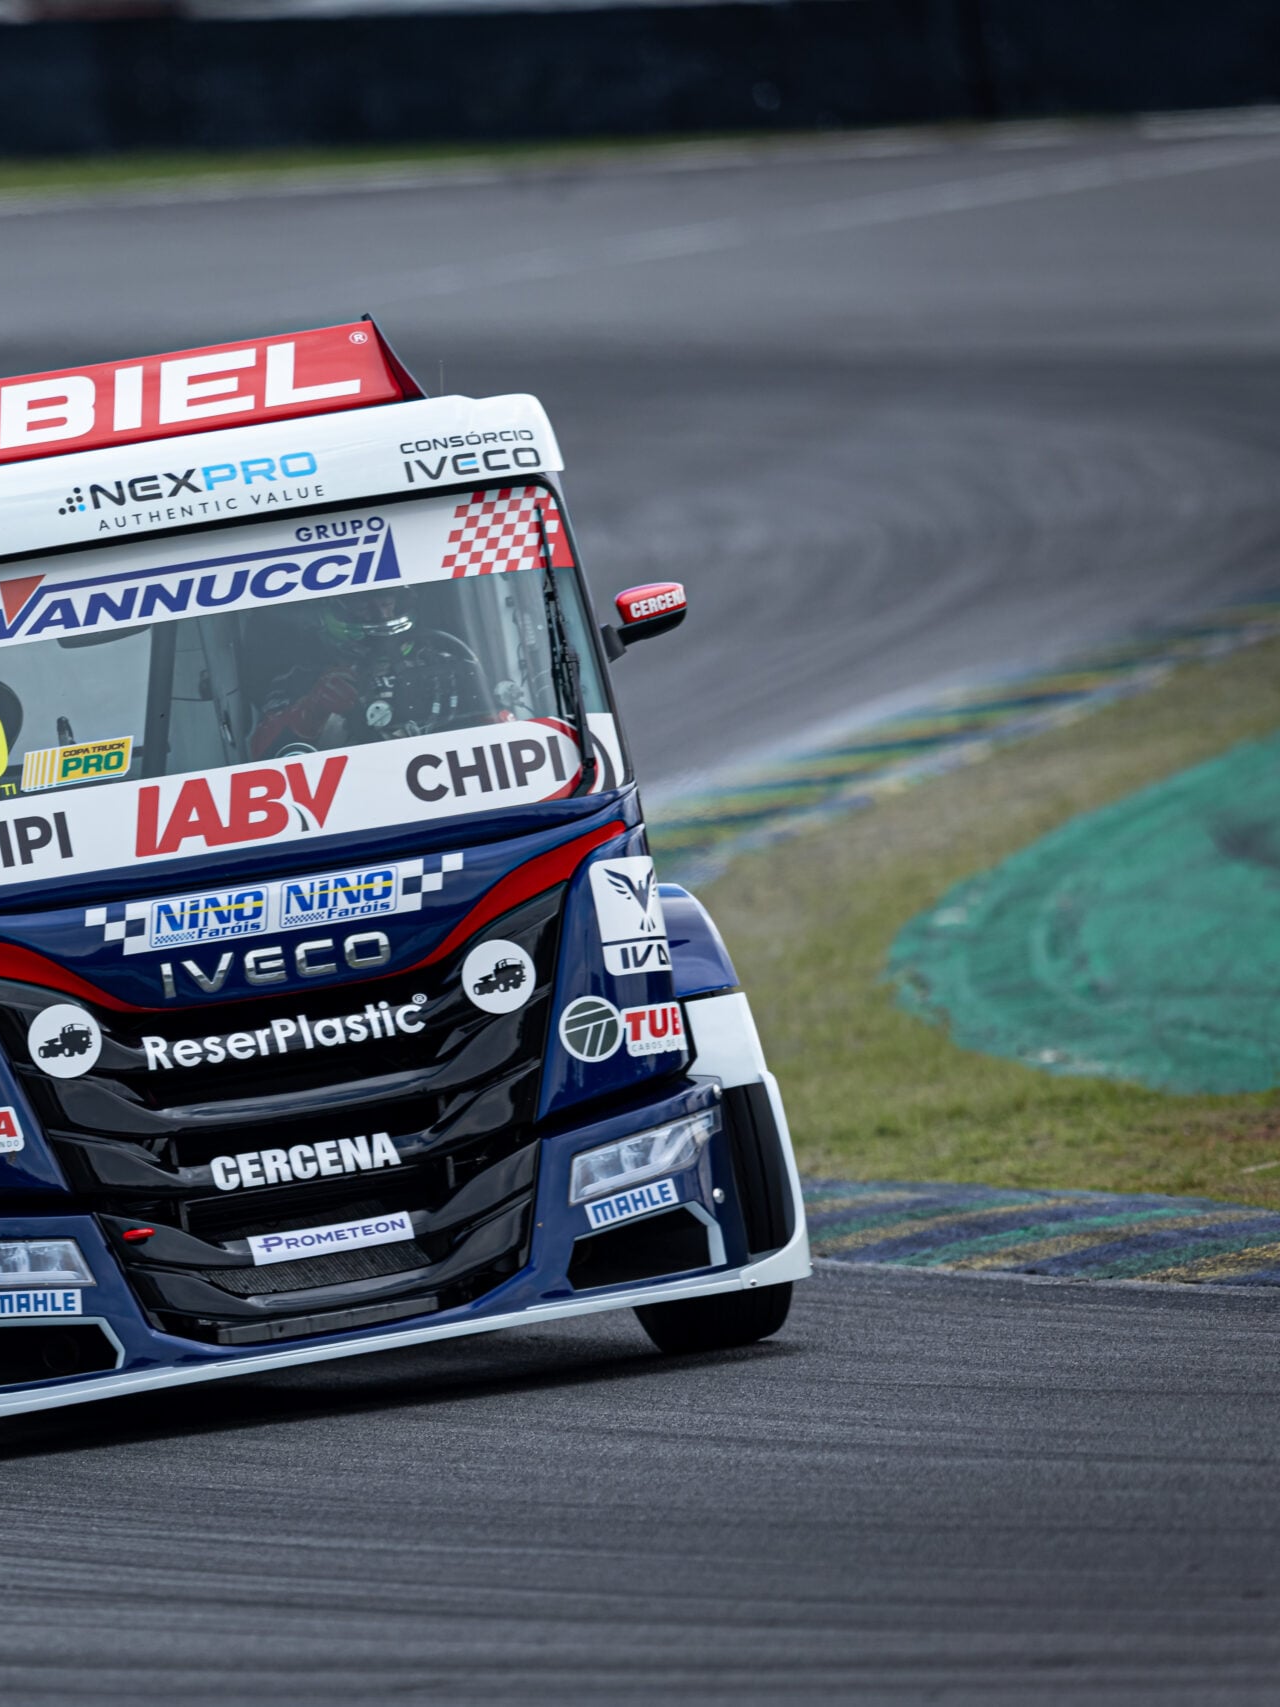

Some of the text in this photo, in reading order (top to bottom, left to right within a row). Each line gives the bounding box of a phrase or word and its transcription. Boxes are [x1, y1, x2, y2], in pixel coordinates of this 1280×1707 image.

[399, 429, 535, 454] CONSÓRCIO
[90, 451, 318, 511] NEXPRO
[404, 446, 541, 483] IVECO
[98, 484, 325, 532] AUTHENTIC VALUE
[295, 516, 385, 543] GRUPO
[61, 751, 124, 778] PRO
[63, 742, 125, 758] COPA TRUCK
[405, 735, 567, 802] CHIPI
[326, 900, 390, 919] Faróis
[197, 920, 261, 939] Faróis
[160, 930, 392, 999] IVECO
[210, 1132, 402, 1191] CERCENA
[592, 1182, 673, 1224] MAHLE
